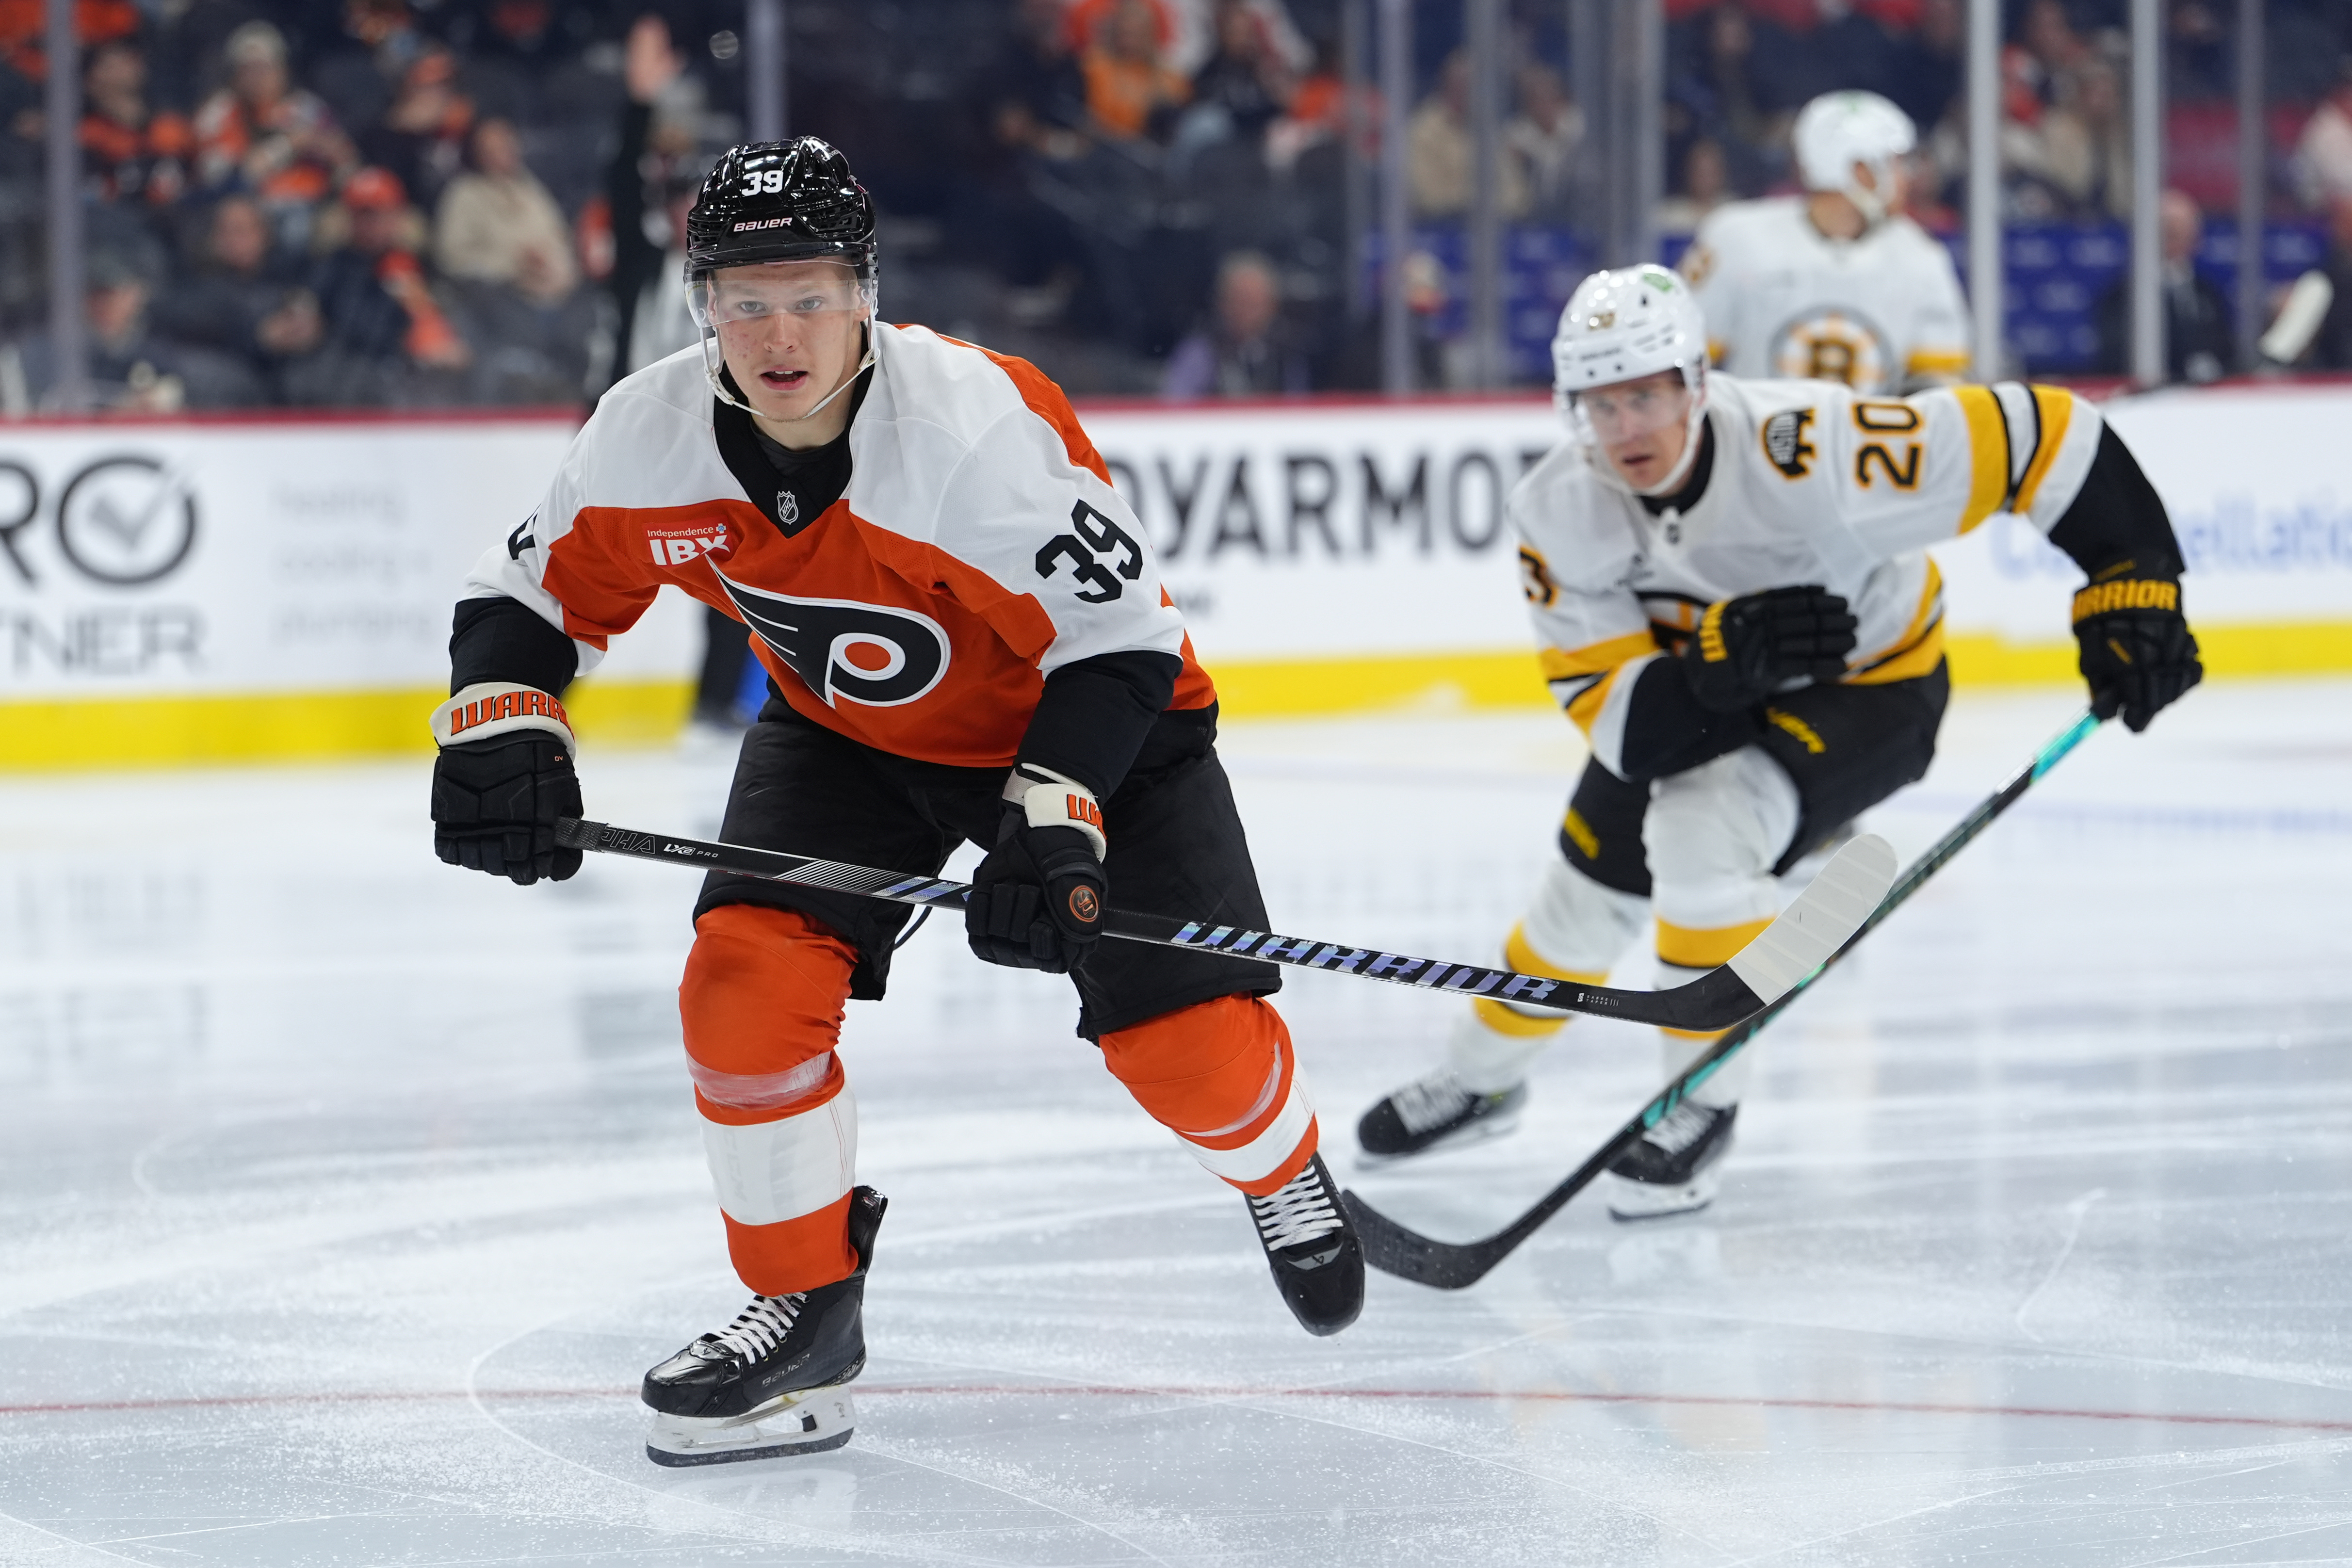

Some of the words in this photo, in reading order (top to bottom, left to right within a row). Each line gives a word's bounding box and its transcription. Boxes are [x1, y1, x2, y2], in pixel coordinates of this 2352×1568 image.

[742, 170, 784, 197] 39
[733, 217, 793, 232] BAUER
[1853, 401, 1925, 492] 20
[1101, 452, 1555, 558] YARMO
[647, 527, 714, 538] Independence
[649, 534, 731, 566] IBX
[1035, 498, 1144, 604] 39
[0, 606, 208, 675] NER
[696, 850, 719, 858] PRO
[1170, 921, 1560, 1002] WARRIOR
